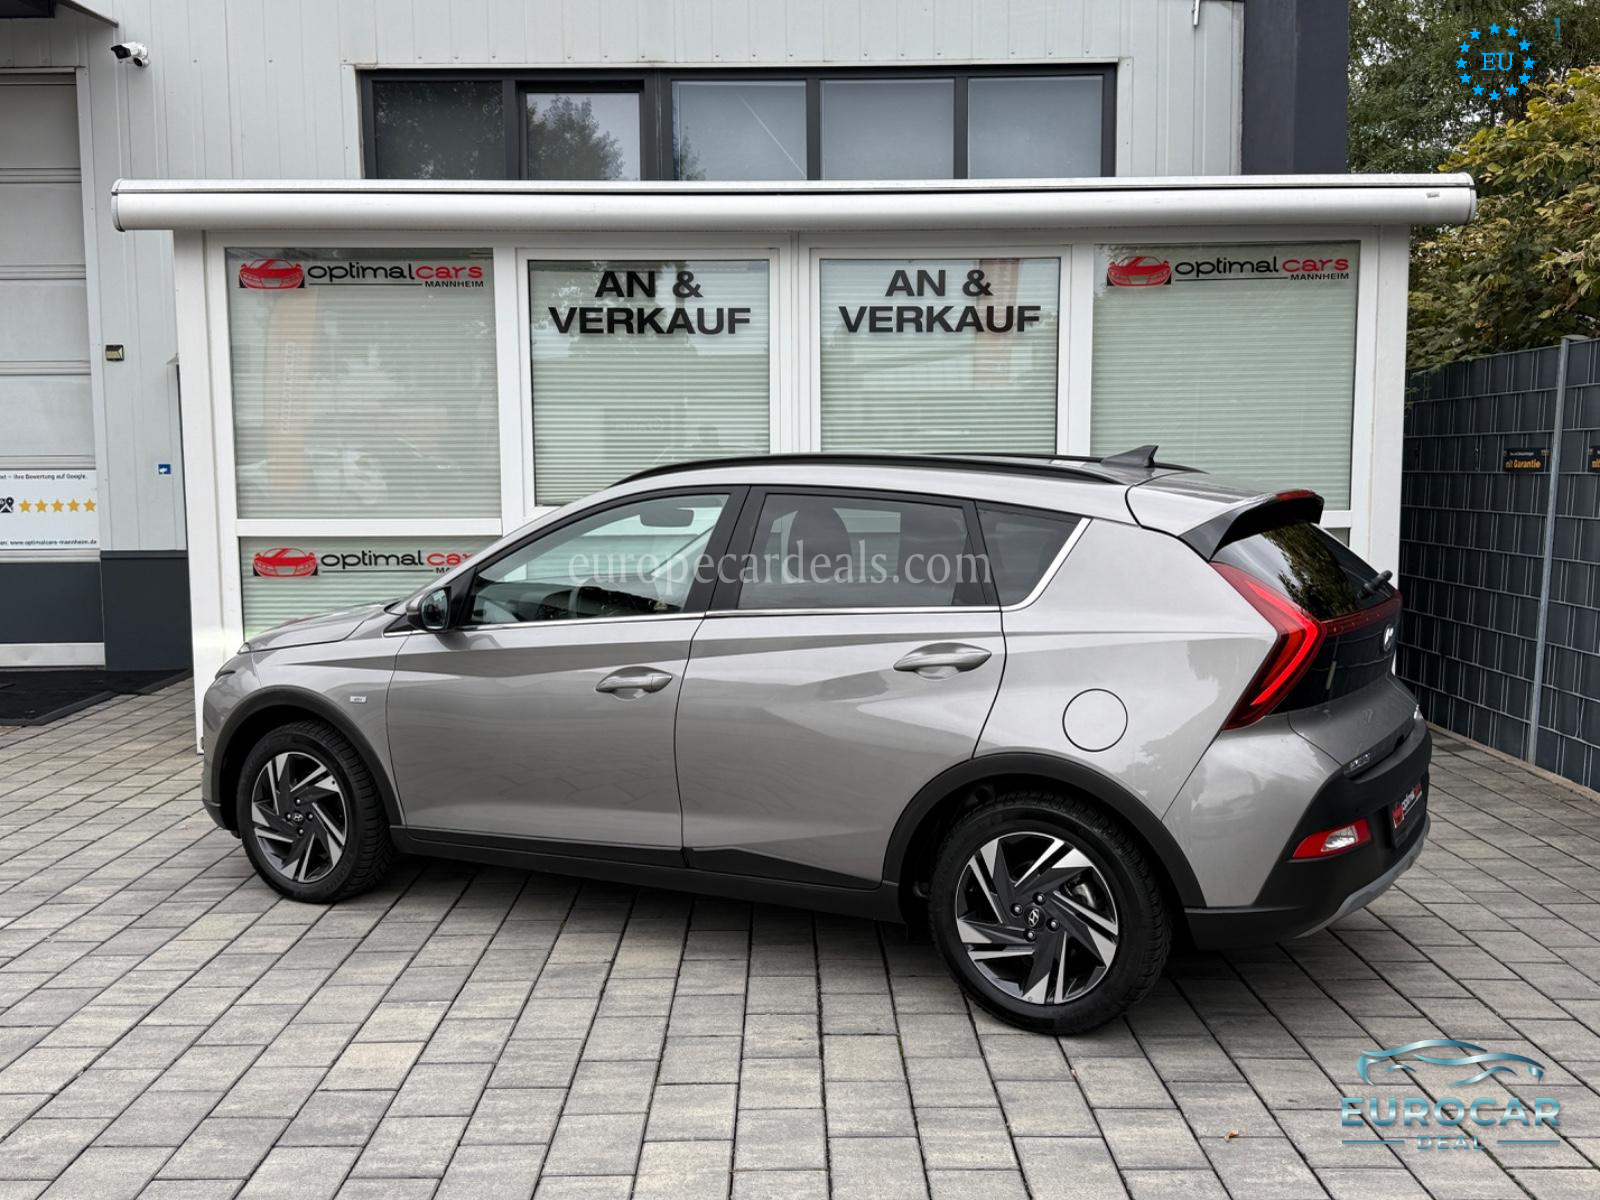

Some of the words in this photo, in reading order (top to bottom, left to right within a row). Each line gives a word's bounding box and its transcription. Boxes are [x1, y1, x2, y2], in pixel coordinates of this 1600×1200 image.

[424, 280, 484, 288] MANNHEIM
[595, 270, 656, 298] AN
[672, 270, 703, 298] &
[885, 269, 946, 297] AN
[962, 269, 993, 297] &
[1289, 272, 1350, 281] MANNHEIM
[548, 306, 752, 335] VERKAUF
[839, 305, 1042, 333] VERKAUF
